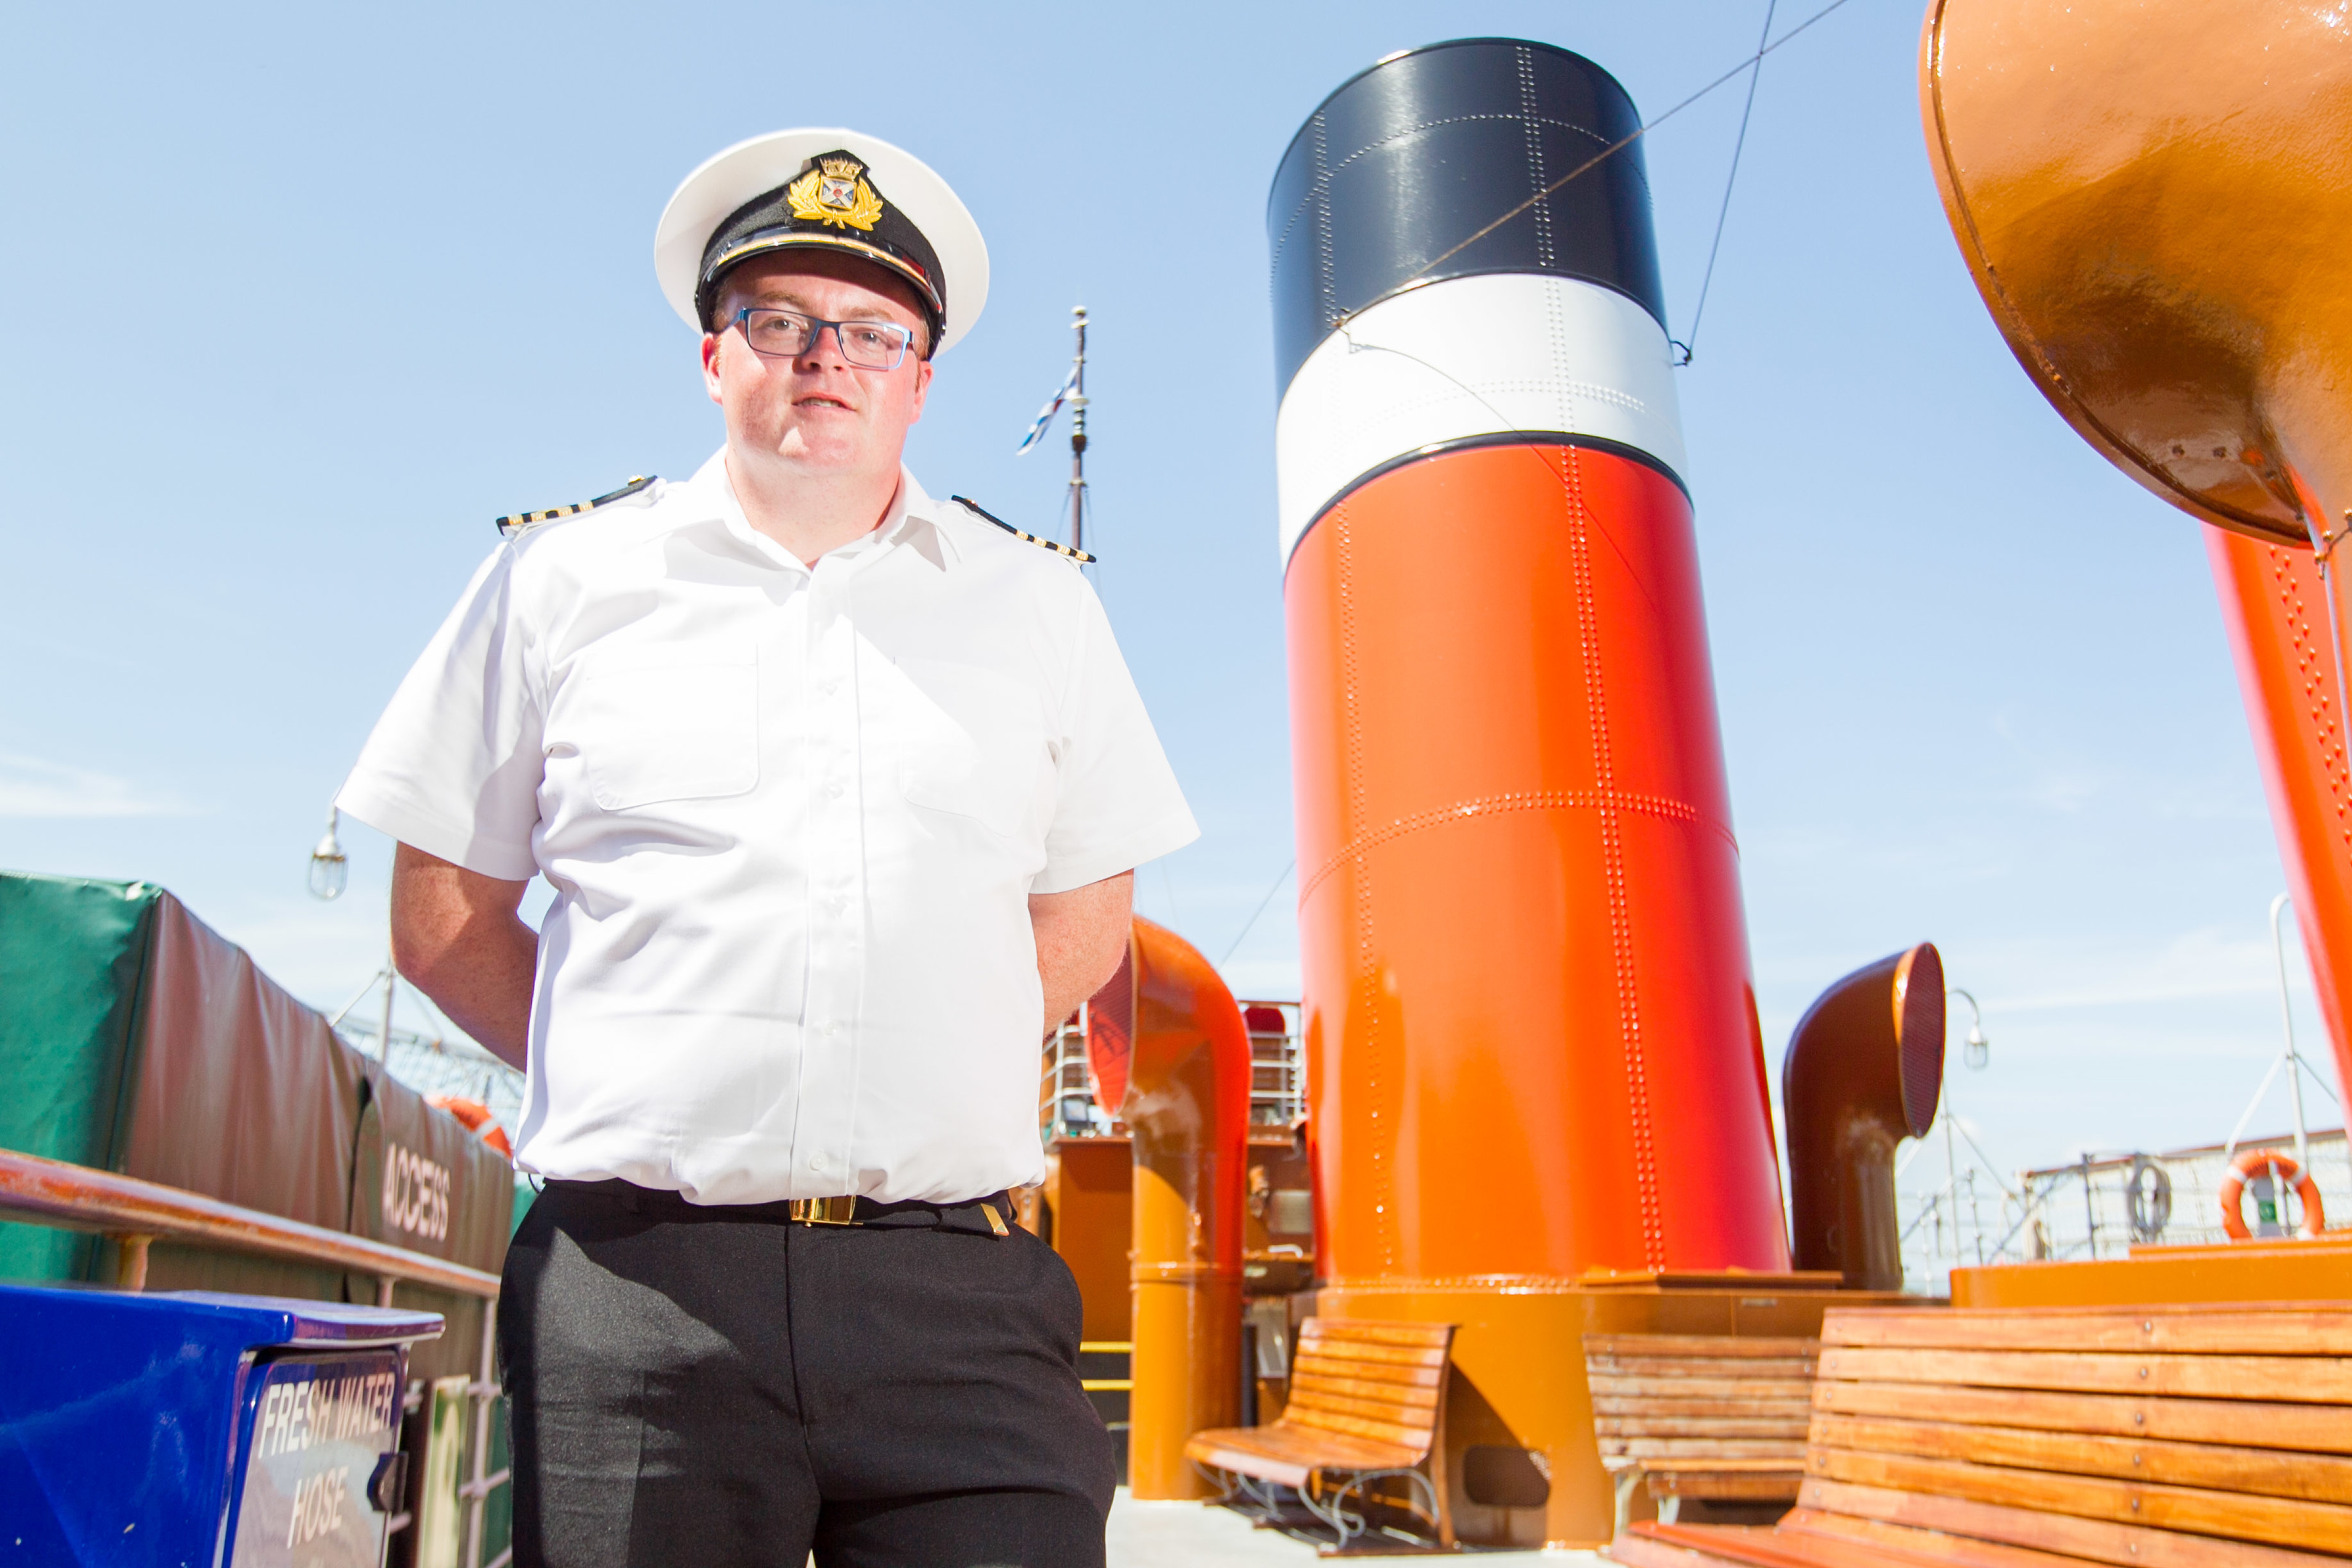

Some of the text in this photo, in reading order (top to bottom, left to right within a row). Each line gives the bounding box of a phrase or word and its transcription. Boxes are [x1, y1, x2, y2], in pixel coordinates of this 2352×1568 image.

[382, 1142, 451, 1243] ACCESS
[258, 1372, 396, 1460] FRESH WATER
[287, 1466, 349, 1549] HOSE
